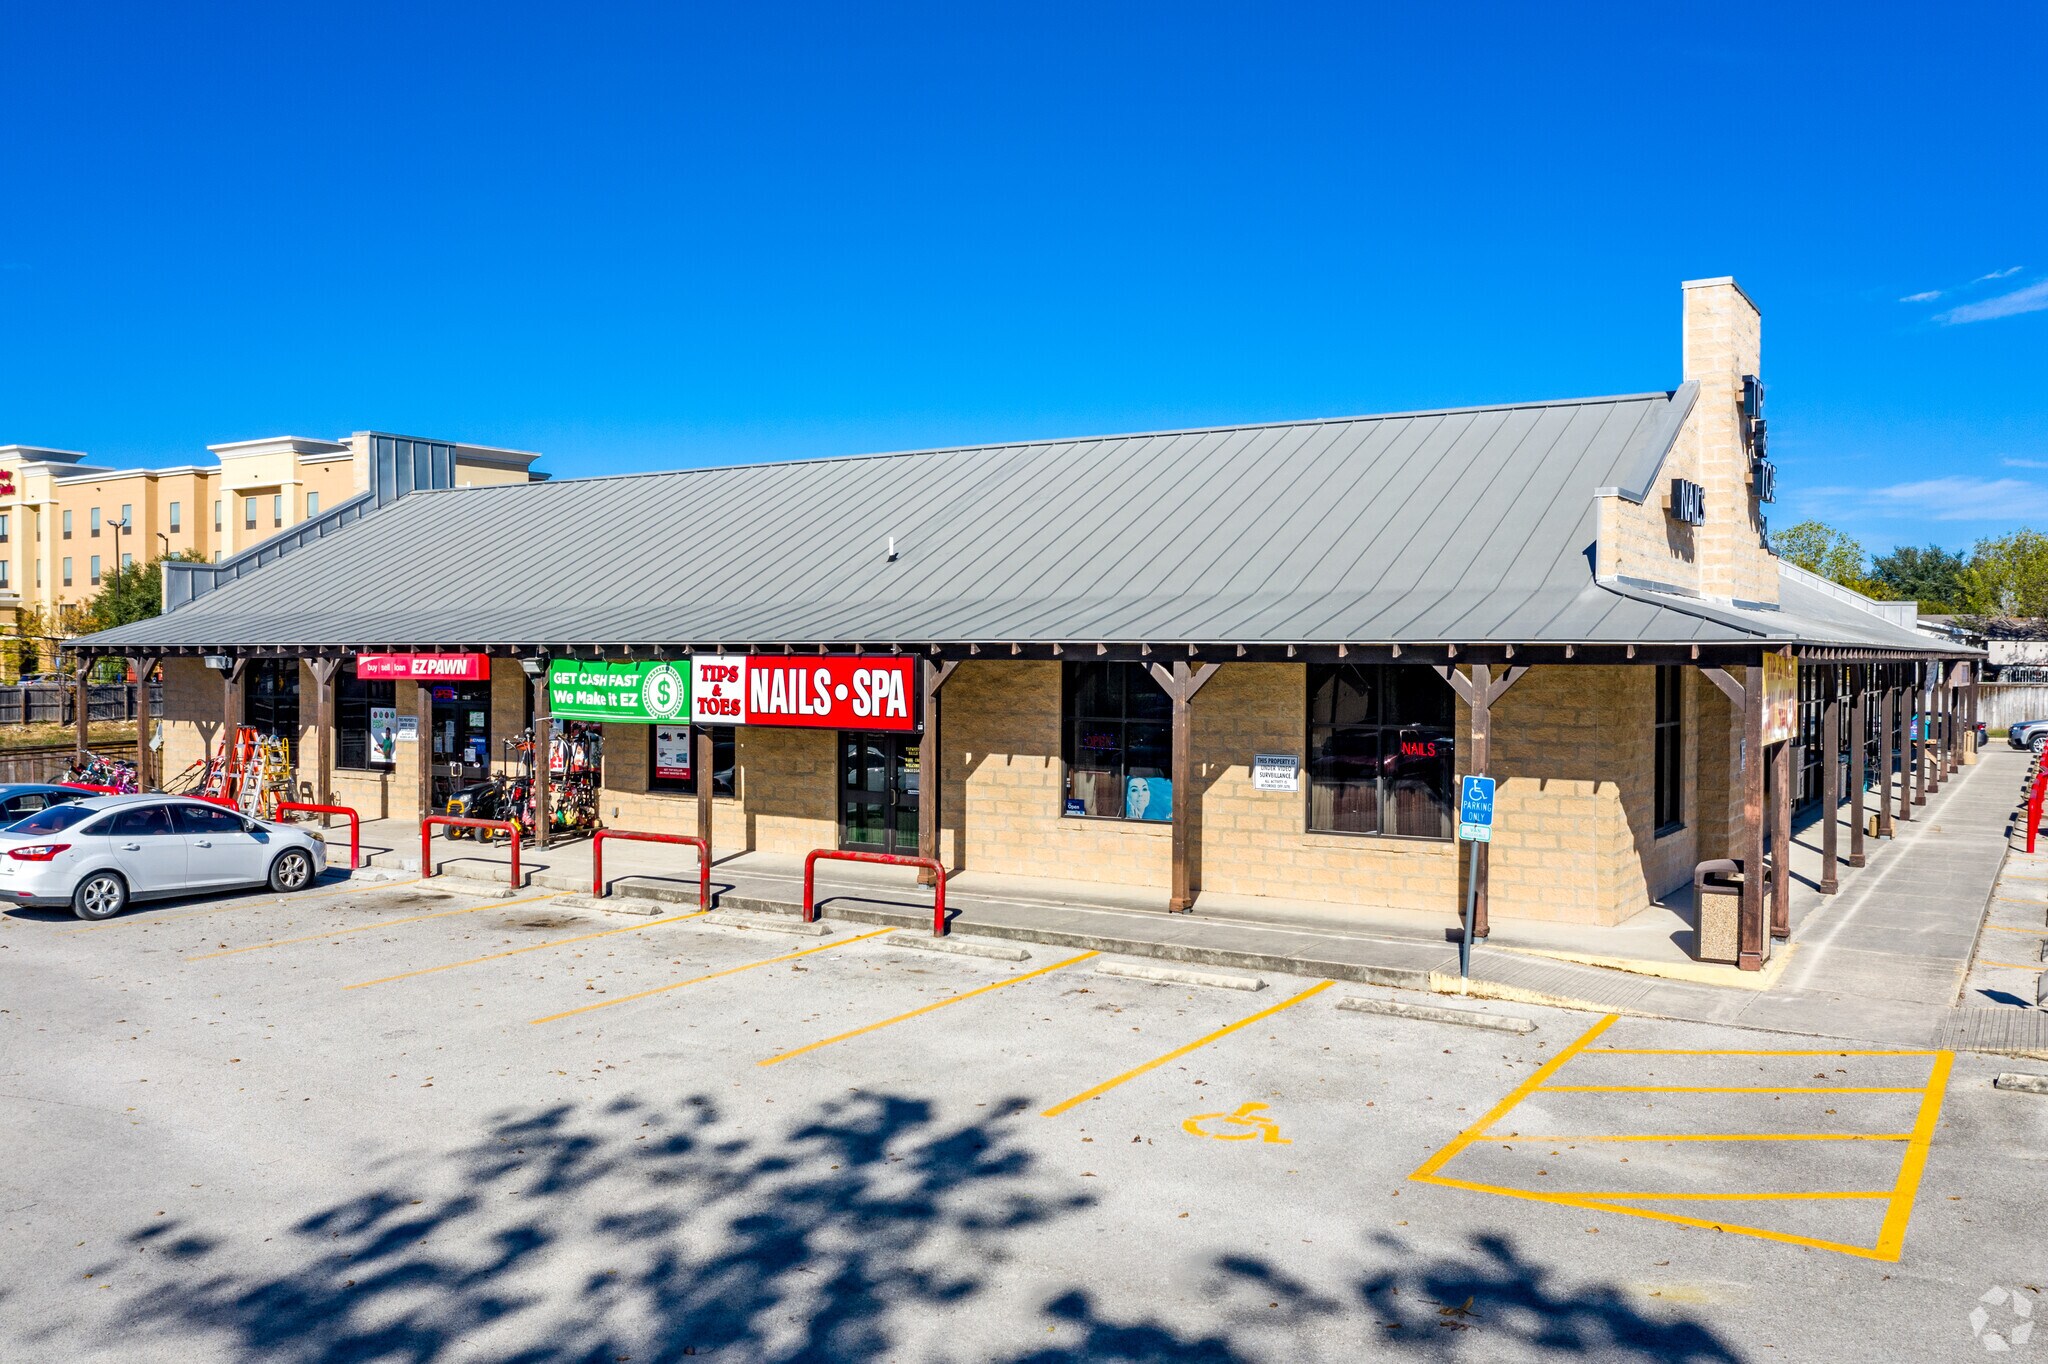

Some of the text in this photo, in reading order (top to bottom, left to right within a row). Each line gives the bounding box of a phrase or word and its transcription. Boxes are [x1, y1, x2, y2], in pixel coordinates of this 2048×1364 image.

[1680, 478, 1706, 528] NAILS
[367, 663, 377, 672] buy
[381, 663, 391, 671] sell
[393, 663, 406, 672] loan
[700, 664, 739, 683] TIPS
[553, 672, 639, 687] GET CASH FAST
[711, 683, 722, 697] &
[750, 667, 908, 718] NAILS SPA
[553, 689, 639, 707] We Make it EZ
[697, 697, 742, 716] TOES
[1086, 735, 1112, 747] OPEN
[1402, 742, 1436, 757] NAILS
[1463, 800, 1492, 812] PARKING
[1468, 811, 1485, 822] ONLY
